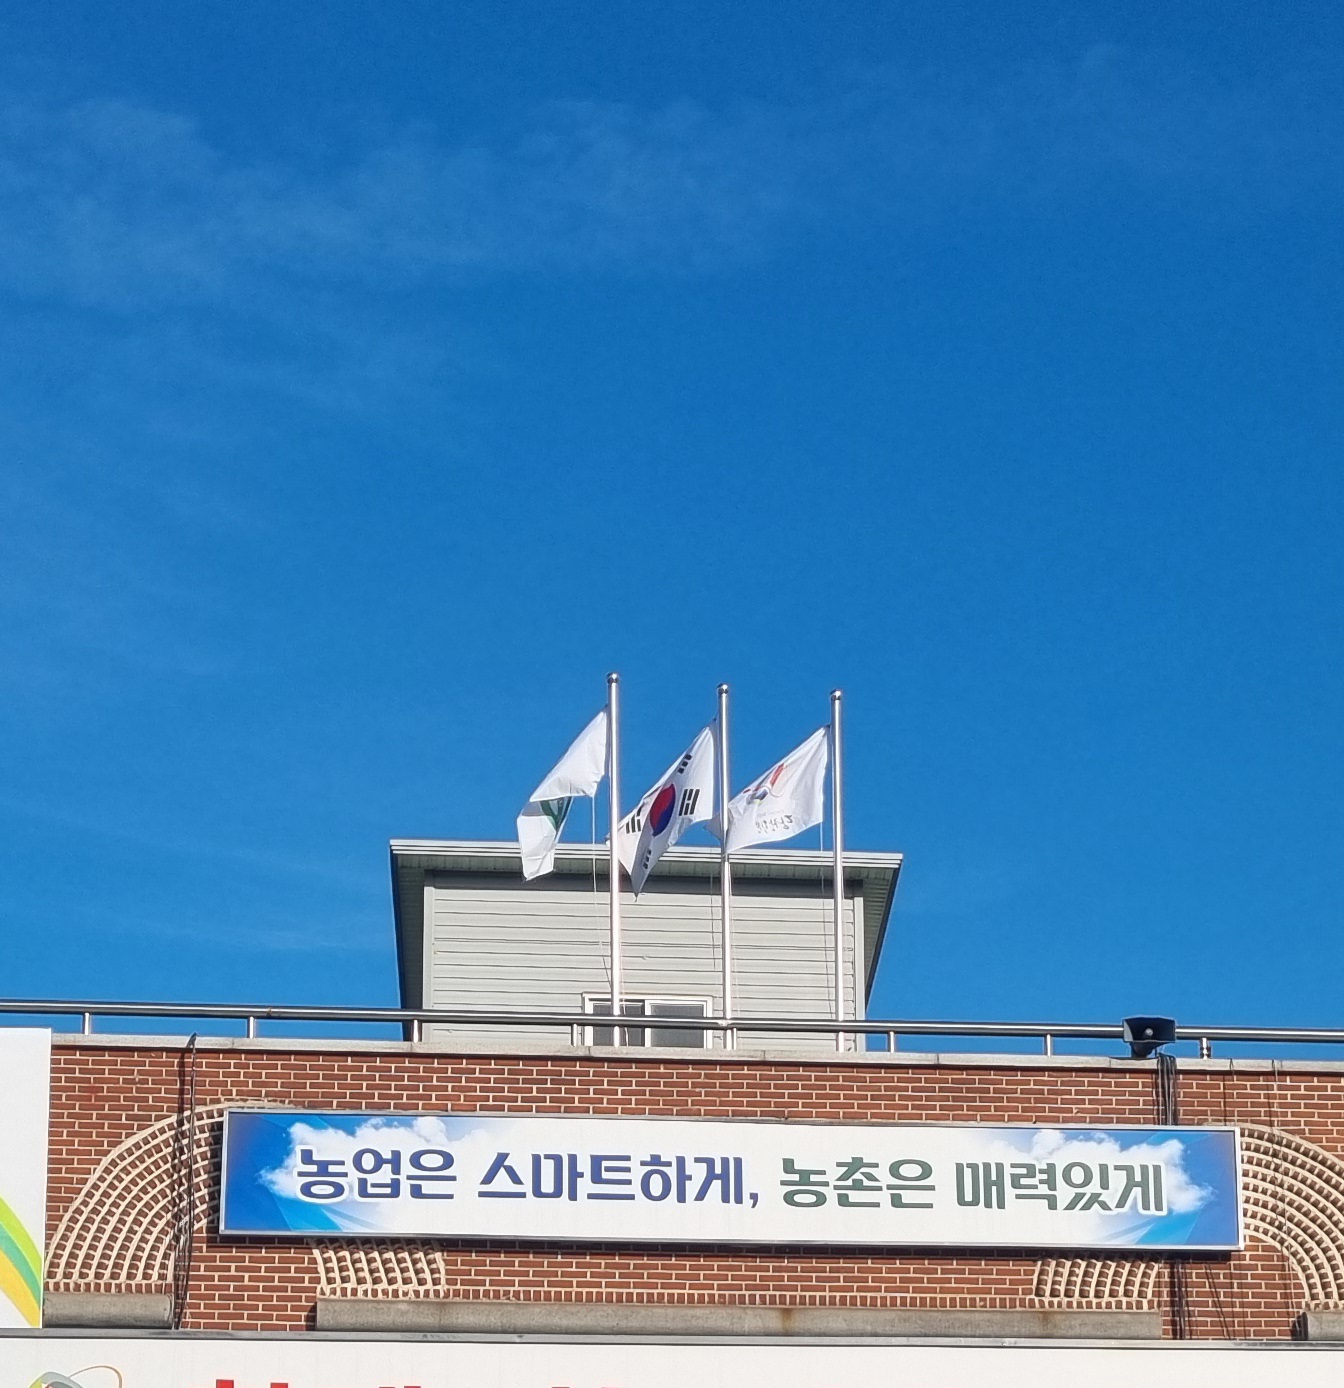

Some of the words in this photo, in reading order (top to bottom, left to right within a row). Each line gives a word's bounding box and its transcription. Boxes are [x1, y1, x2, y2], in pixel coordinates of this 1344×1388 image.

[296, 1147, 457, 1201] 농업은
[477, 1151, 760, 1209] 스마트하게,
[779, 1157, 936, 1209] 농촌은
[955, 1161, 1169, 1213] 매력있게
